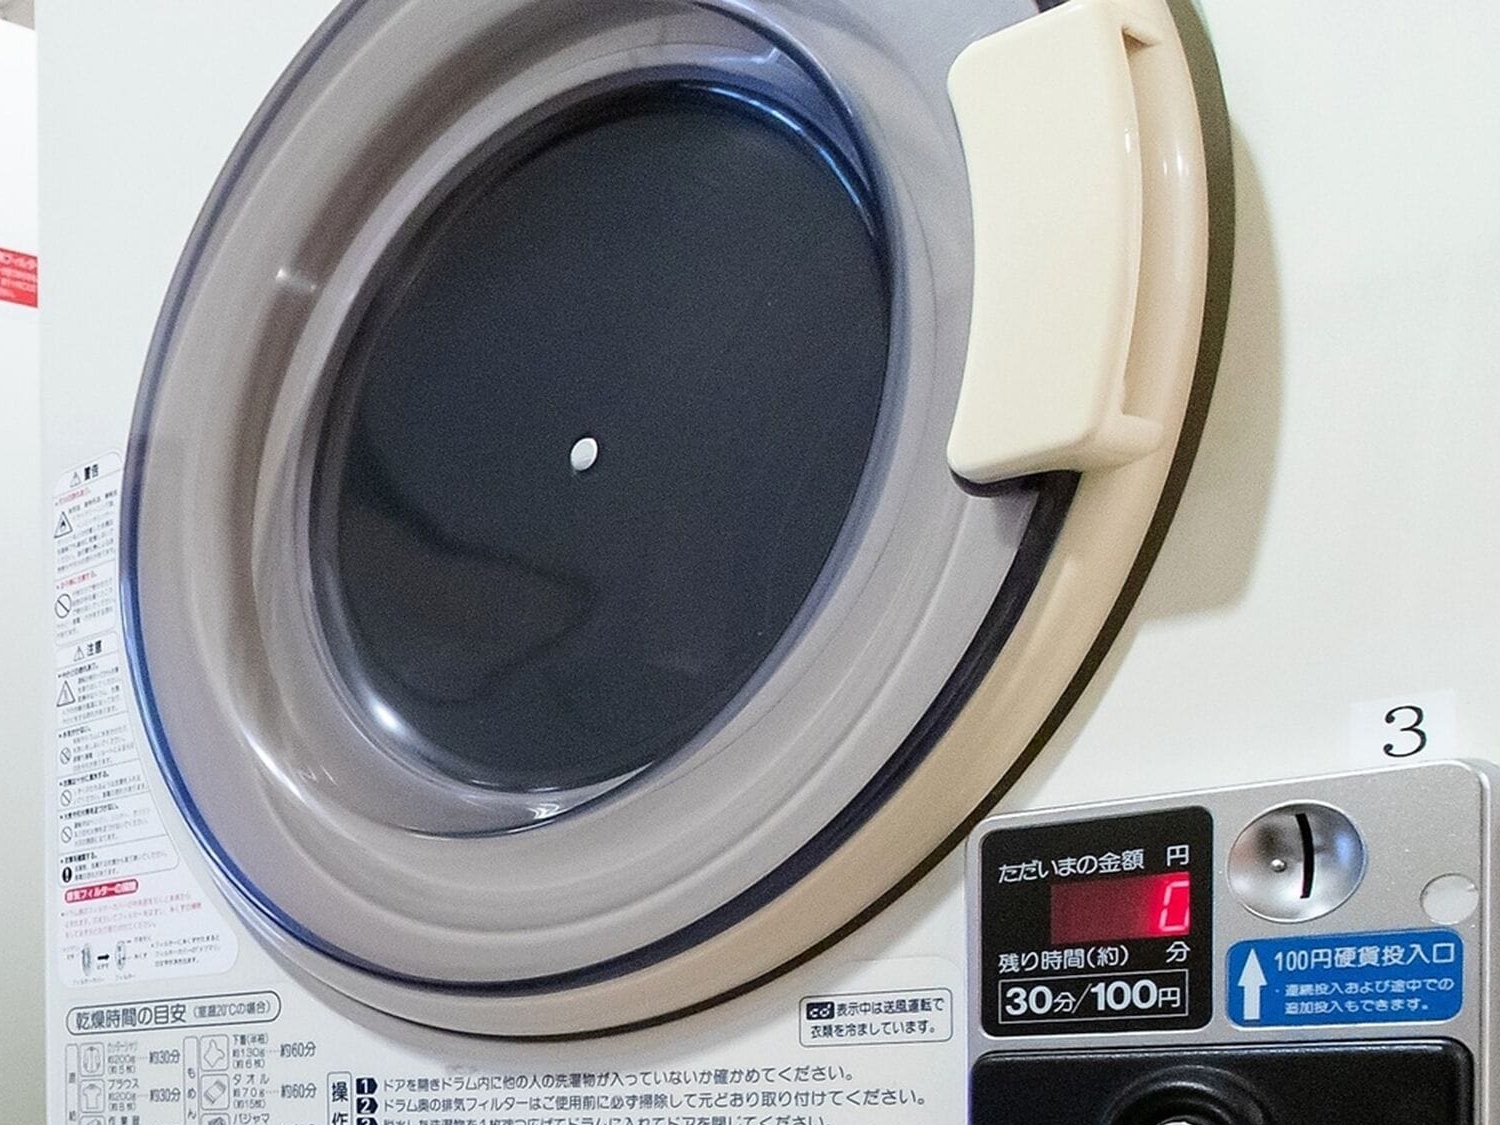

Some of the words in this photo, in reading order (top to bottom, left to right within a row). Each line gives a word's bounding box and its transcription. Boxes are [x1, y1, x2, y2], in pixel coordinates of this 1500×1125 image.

[1383, 705, 1428, 758] 3
[998, 849, 1145, 883] ただいまの金額
[1166, 845, 1190, 866] 円
[1158, 880, 1190, 932] 0
[1165, 941, 1191, 963] 分
[1274, 943, 1455, 971] 100円硬貨投入口
[836, 997, 945, 1017] 表示中は送風運転で
[1005, 979, 1181, 1016] 30分/100円
[1285, 999, 1428, 1015] 追加投入もできます。
[76, 1004, 187, 1030] 乾燥時間の目安
[810, 1020, 936, 1038] 衣類を冷ましています。
[280, 1041, 316, 1058] 約60分
[108, 1079, 139, 1089] ブラウス
[233, 1075, 270, 1086] タオル
[281, 1083, 317, 1099] 約60分
[234, 1113, 270, 1124] パジャマ
